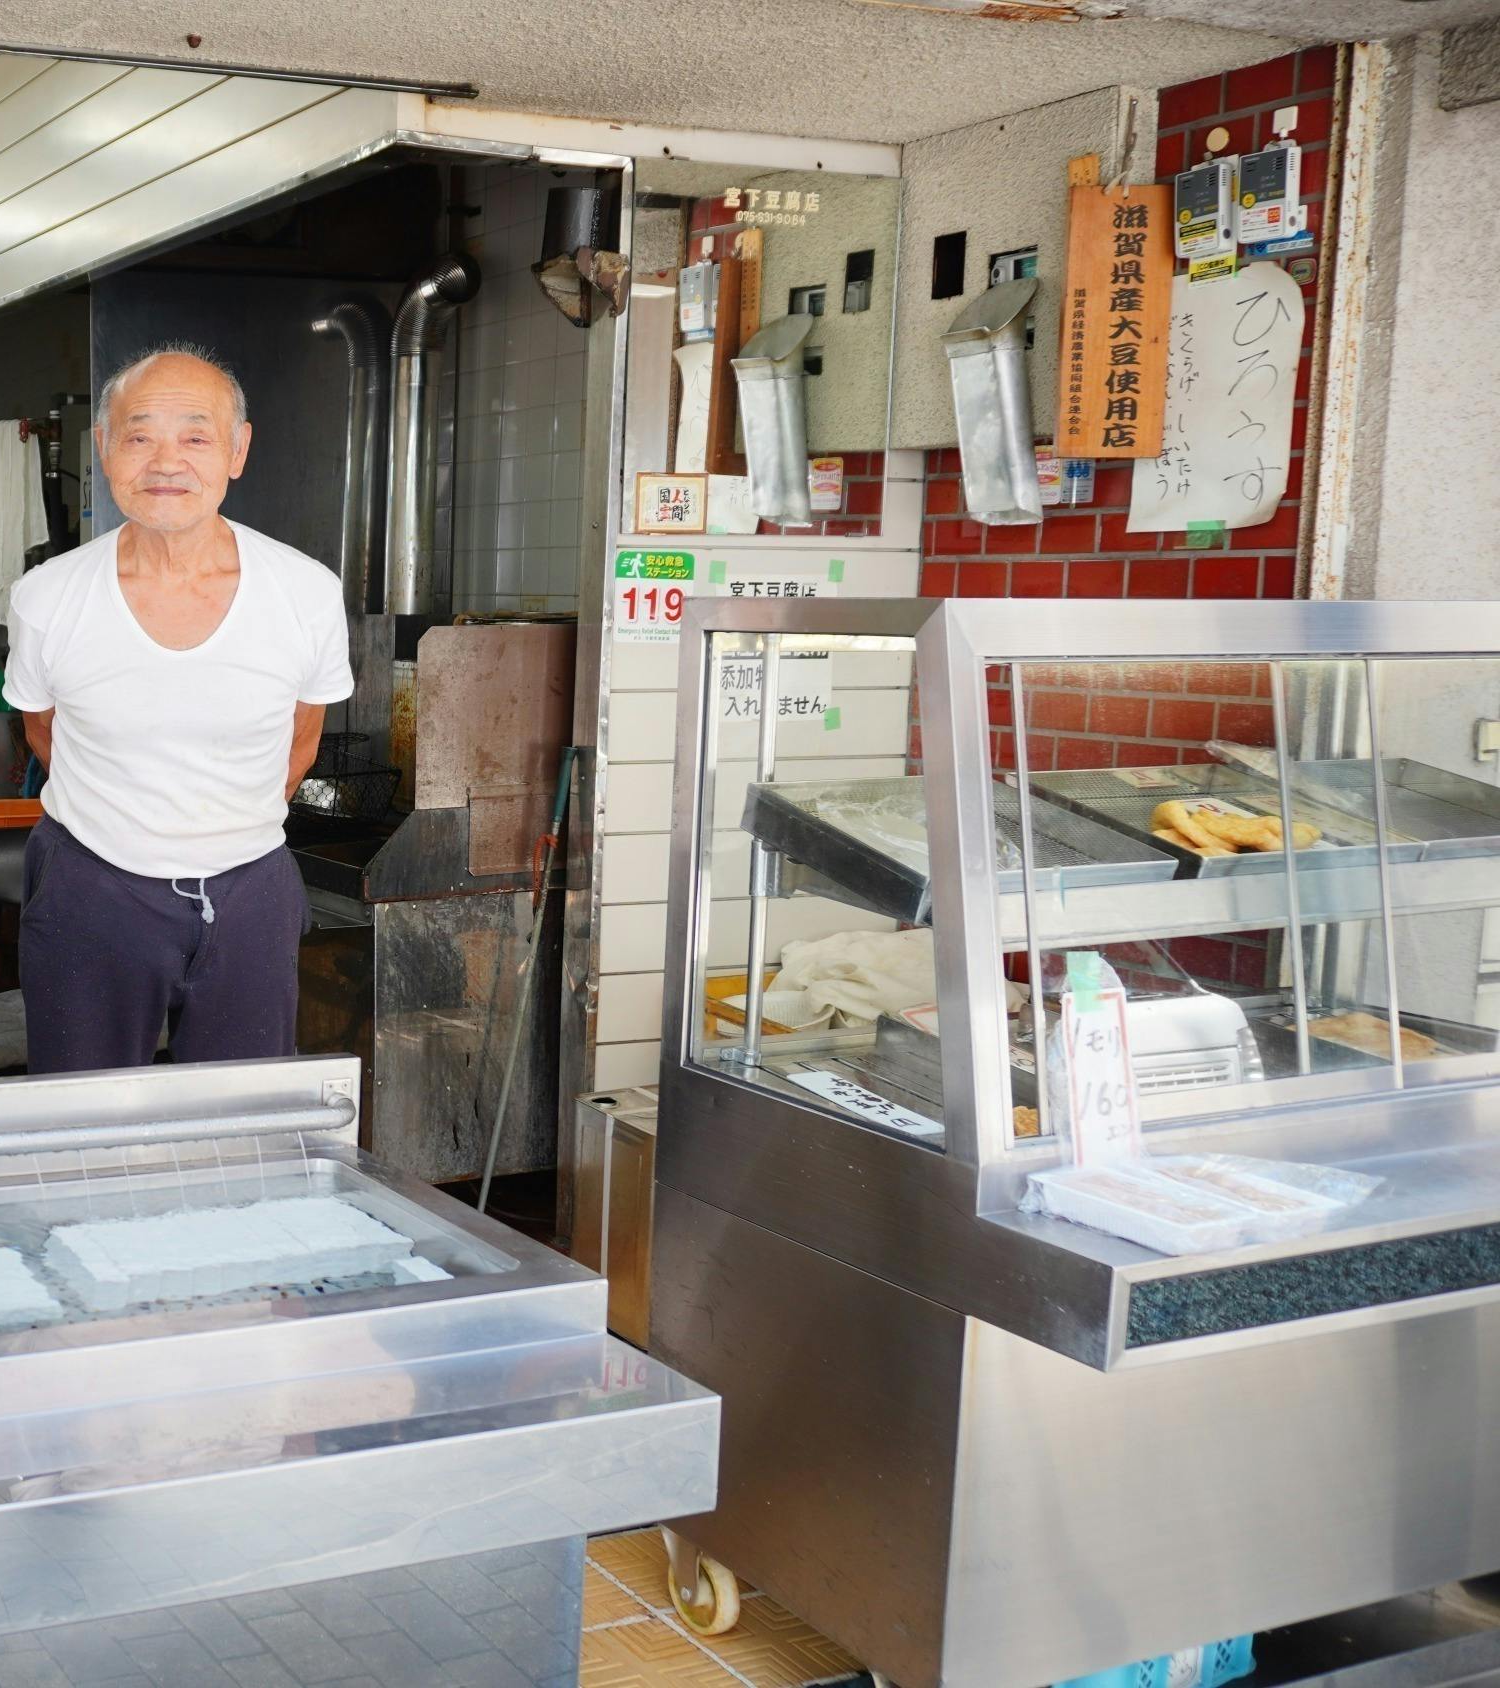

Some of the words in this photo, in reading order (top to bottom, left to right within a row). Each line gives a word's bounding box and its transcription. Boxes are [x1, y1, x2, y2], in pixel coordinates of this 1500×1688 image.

[723, 187, 820, 212] 宮下豆腐店
[1101, 204, 1149, 448] 滋賀県産大豆使用店
[1223, 291, 1291, 511] ひろうす
[645, 554, 684, 567] 安心救急
[645, 566, 690, 578] ステーション
[623, 587, 684, 621] 119
